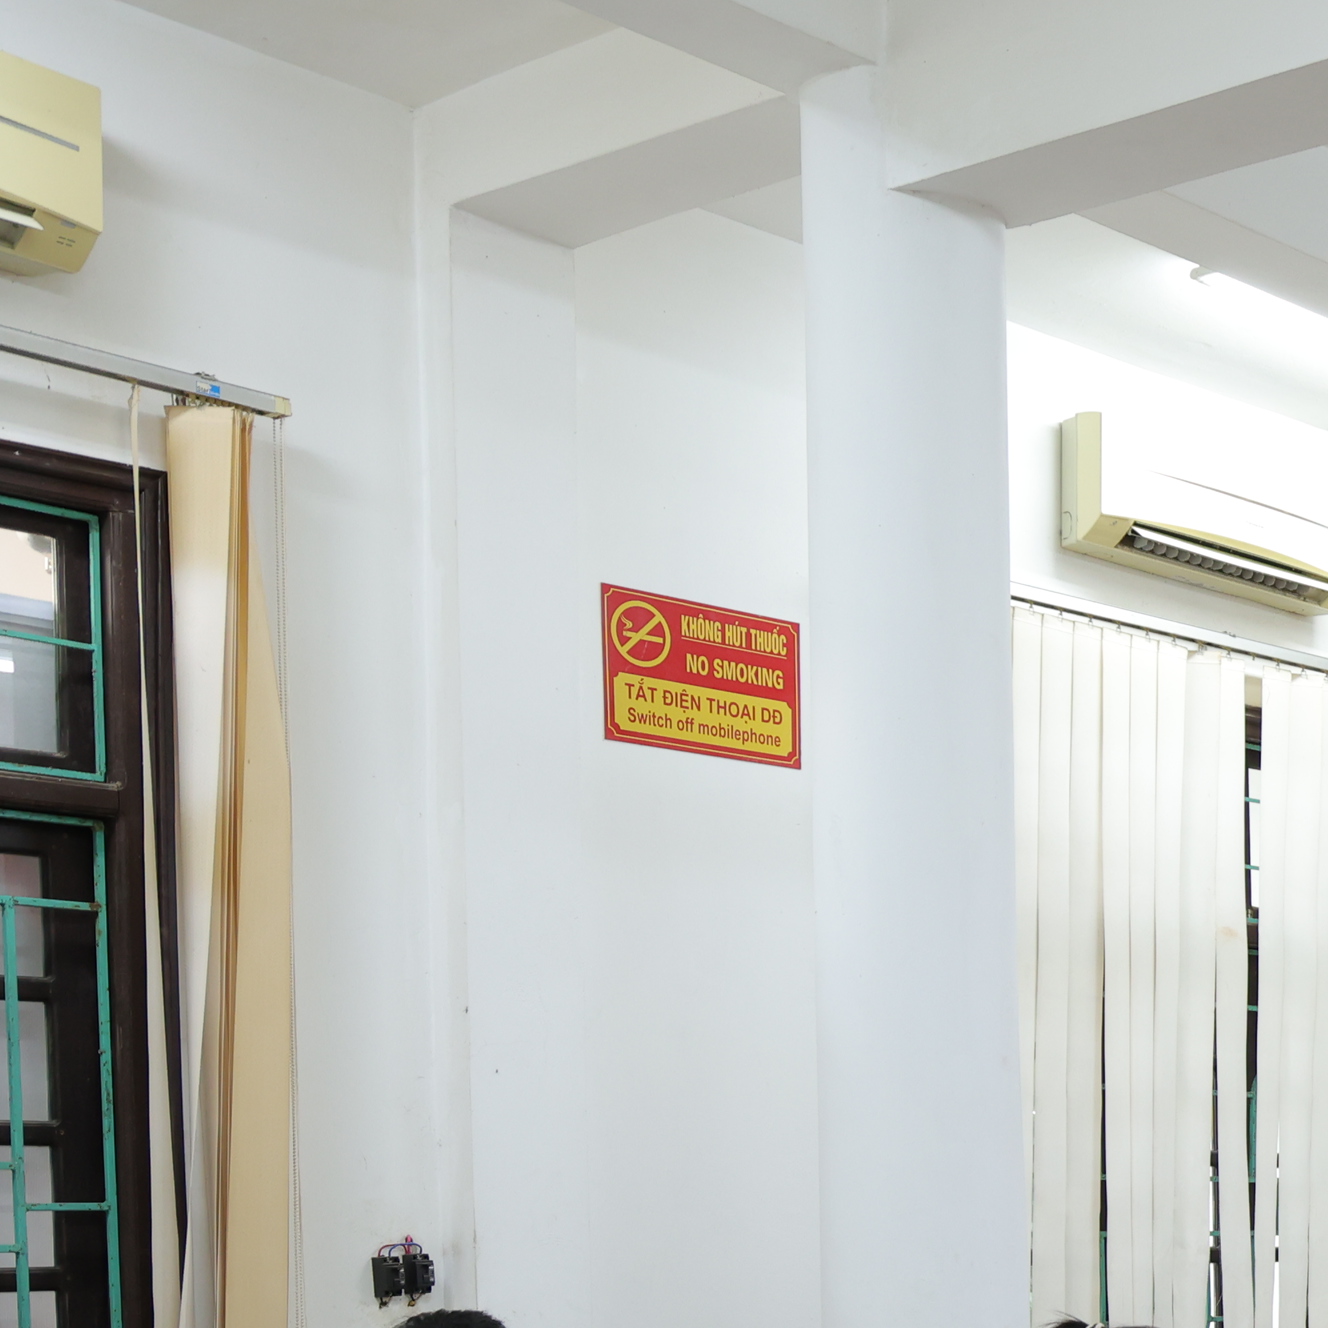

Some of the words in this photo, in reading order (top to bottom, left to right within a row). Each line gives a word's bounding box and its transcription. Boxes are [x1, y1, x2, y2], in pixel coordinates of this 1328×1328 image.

[681, 613, 722, 644] KHÔNG
[725, 620, 747, 648] HÚT
[750, 625, 787, 656] THUỐC
[686, 653, 709, 676] NO
[713, 659, 784, 690] SMOKING
[624, 678, 658, 704] TẮT
[662, 689, 702, 714] ĐIỆN
[706, 697, 757, 724] THOẠI
[761, 707, 783, 726] DĐ
[627, 707, 673, 730] Switch
[677, 716, 695, 732] off
[698, 721, 782, 748] mobilephone
